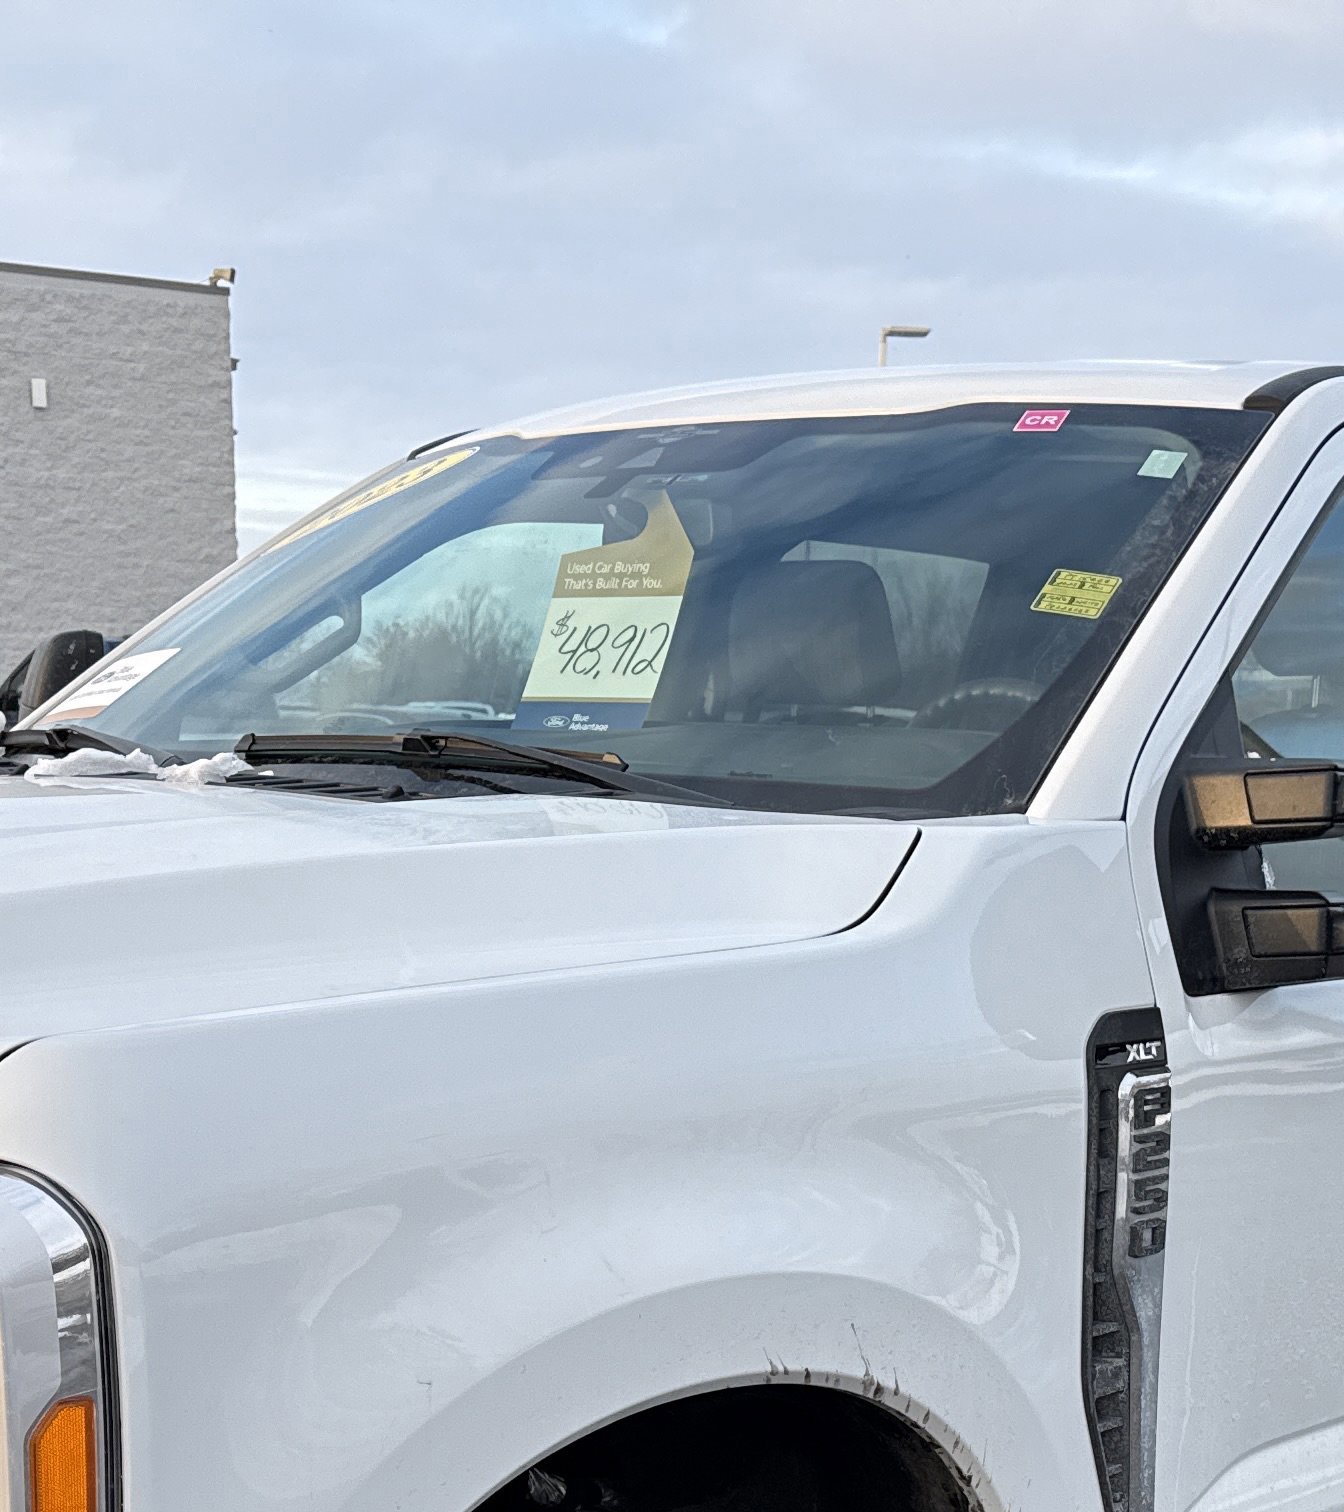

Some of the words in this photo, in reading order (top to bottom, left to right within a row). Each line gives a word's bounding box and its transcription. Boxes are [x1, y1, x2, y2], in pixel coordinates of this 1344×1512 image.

[1025, 415, 1059, 425] CR
[567, 562, 594, 574] Used
[595, 561, 613, 574] Car
[614, 560, 651, 575] Buying
[564, 578, 594, 590] That's
[595, 577, 620, 589] Built
[622, 577, 639, 589] For
[642, 576, 664, 589] You.
[551, 610, 670, 680] $48,912
[572, 713, 590, 722] Blue
[1125, 1041, 1162, 1063] XLT
